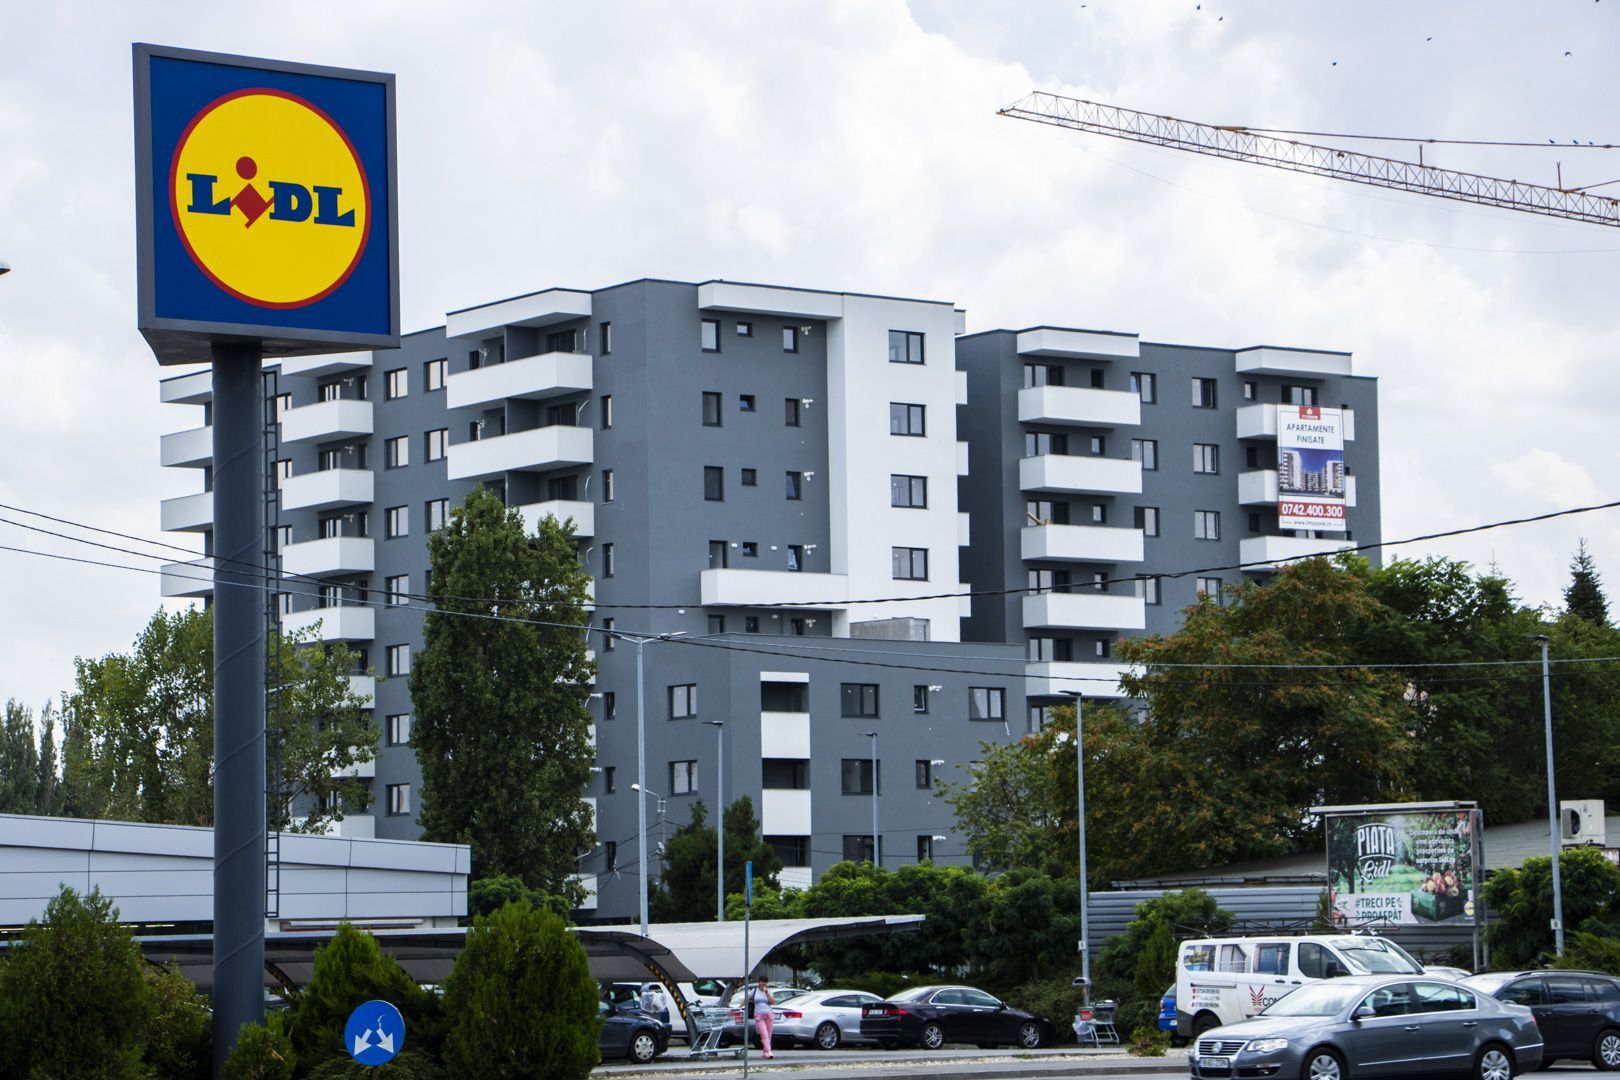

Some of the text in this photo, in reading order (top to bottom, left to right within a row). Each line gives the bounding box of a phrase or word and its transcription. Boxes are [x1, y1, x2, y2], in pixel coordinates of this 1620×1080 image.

[1286, 423, 1335, 434] APARTAMENTE
[1296, 435, 1325, 444] FINISATE
[1281, 504, 1343, 517] 0742.400.300
[1361, 859, 1391, 883] Lidl
[1355, 897, 1396, 908] #TRECI PE
